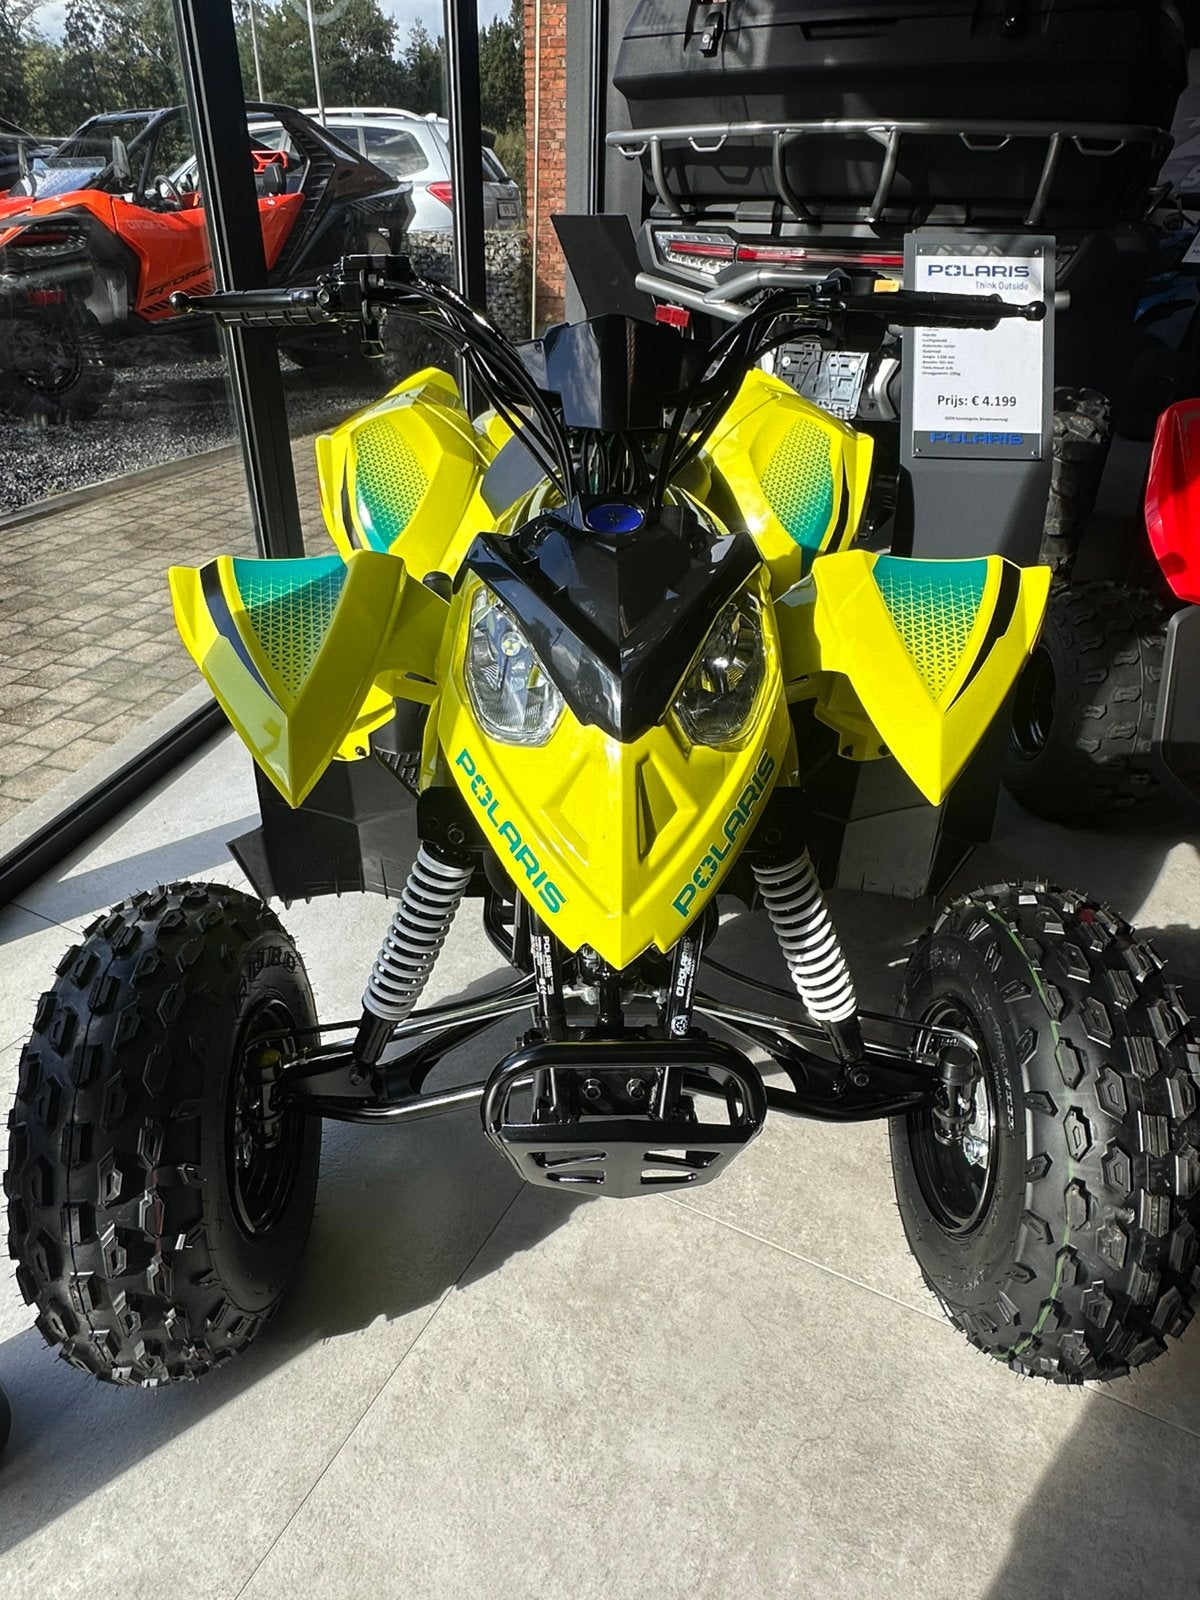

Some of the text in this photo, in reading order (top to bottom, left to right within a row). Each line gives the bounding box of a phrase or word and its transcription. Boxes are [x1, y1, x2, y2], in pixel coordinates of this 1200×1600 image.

[144, 262, 213, 298] ZFORC
[927, 264, 1030, 278] POLARIS
[975, 281, 1029, 291] Think Outside
[937, 394, 1017, 408] Prijs: € 4.199
[929, 431, 1023, 445] POLARIS
[455, 748, 566, 913] POLARIS
[672, 749, 780, 918] POLARIS
[543, 935, 554, 978] POLARIS
